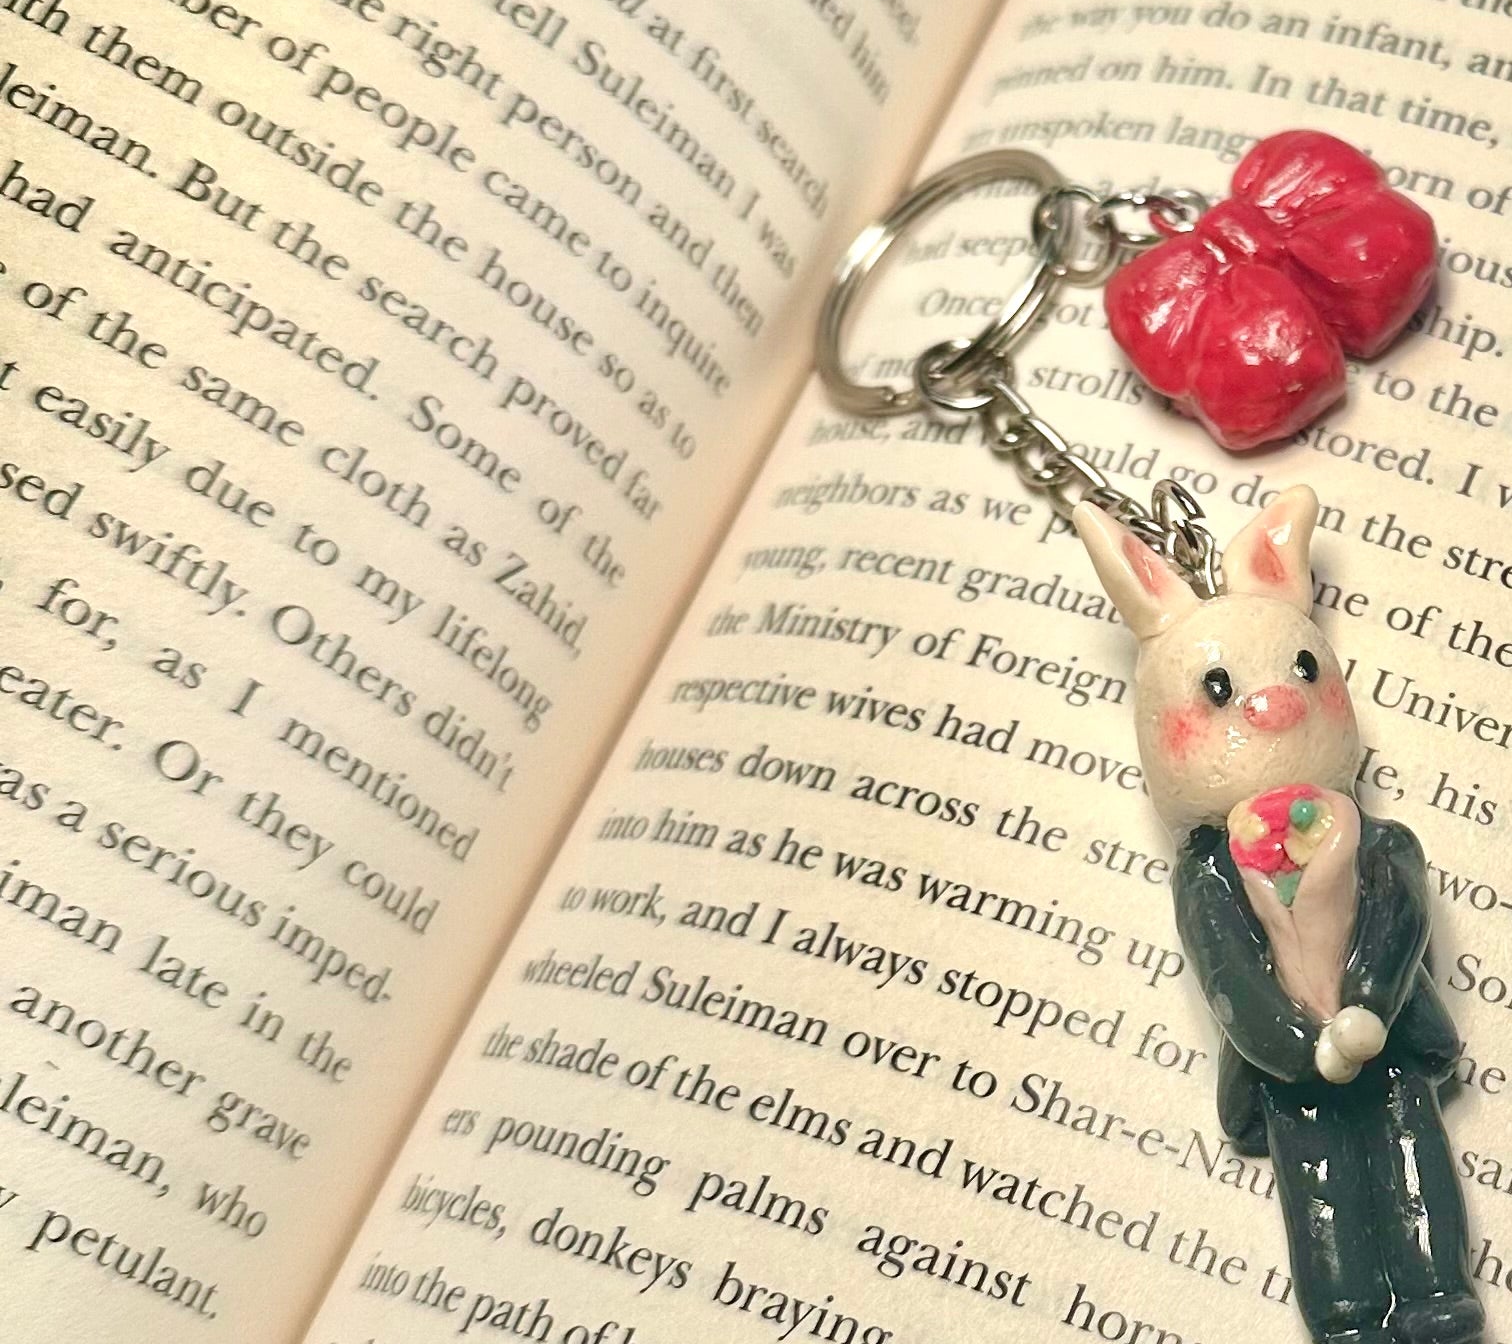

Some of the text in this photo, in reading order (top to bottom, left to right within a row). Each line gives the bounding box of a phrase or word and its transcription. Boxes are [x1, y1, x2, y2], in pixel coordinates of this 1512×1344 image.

[1323, 16, 1450, 69] infant,
[390, 16, 501, 100] right
[500, 93, 641, 206] person
[1427, 380, 1499, 427] the
[21, 282, 587, 659] of the same cloth as Zahid,
[1362, 514, 1432, 558] the
[1387, 606, 1442, 638] of
[35, 578, 479, 862] for, as I mentioned
[1429, 772, 1497, 825] his
[55, 801, 392, 1004] a serious imped-
[598, 807, 648, 841] into
[653, 808, 719, 849] him
[723, 830, 766, 857] as
[771, 828, 823, 869] he
[835, 852, 907, 891] was
[919, 874, 1115, 966] warming
[1127, 939, 1185, 987] up
[441, 1110, 479, 1135] ers
[483, 1117, 670, 1197] pounding
[685, 1172, 829, 1235] palms
[857, 1226, 1031, 1307] against
[482, 1023, 522, 1060] the
[524, 1028, 620, 1079] shade
[625, 1051, 670, 1092] of
[670, 1056, 741, 1112] the
[749, 1088, 852, 1146] elms
[857, 1129, 953, 1178] and
[963, 1160, 1160, 1252] watched
[1169, 1229, 1247, 1285] the
[25, 1211, 216, 1319] petulant.
[400, 1174, 505, 1240] bicycles,
[530, 1208, 692, 1294] donkeys
[358, 1253, 411, 1298] into
[411, 1266, 465, 1313] the
[460, 1289, 555, 1344] path
